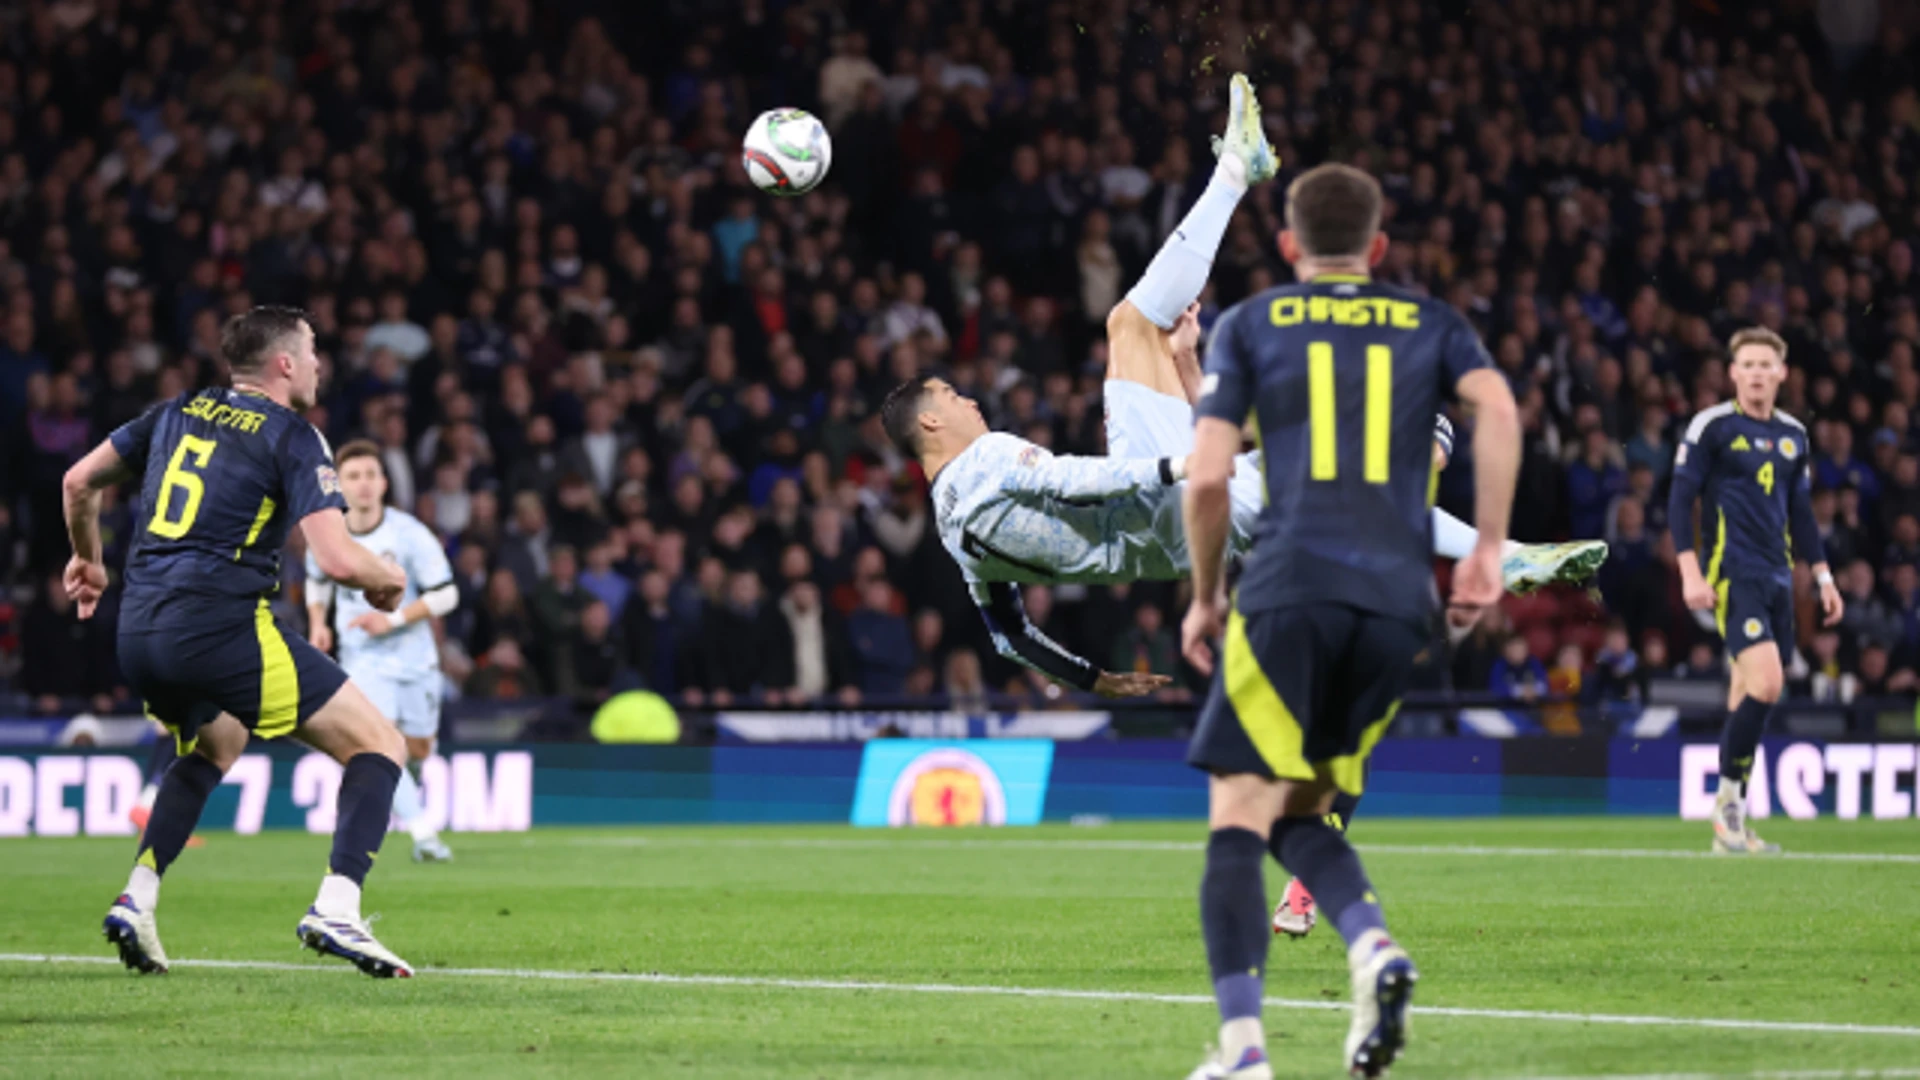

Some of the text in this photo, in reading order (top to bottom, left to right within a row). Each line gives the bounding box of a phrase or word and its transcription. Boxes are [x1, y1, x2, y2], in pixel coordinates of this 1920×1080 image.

[1269, 295, 1420, 330] CHRISTIE
[1308, 341, 1392, 484] 11
[148, 433, 217, 539] 6
[1757, 461, 1775, 495] 4
